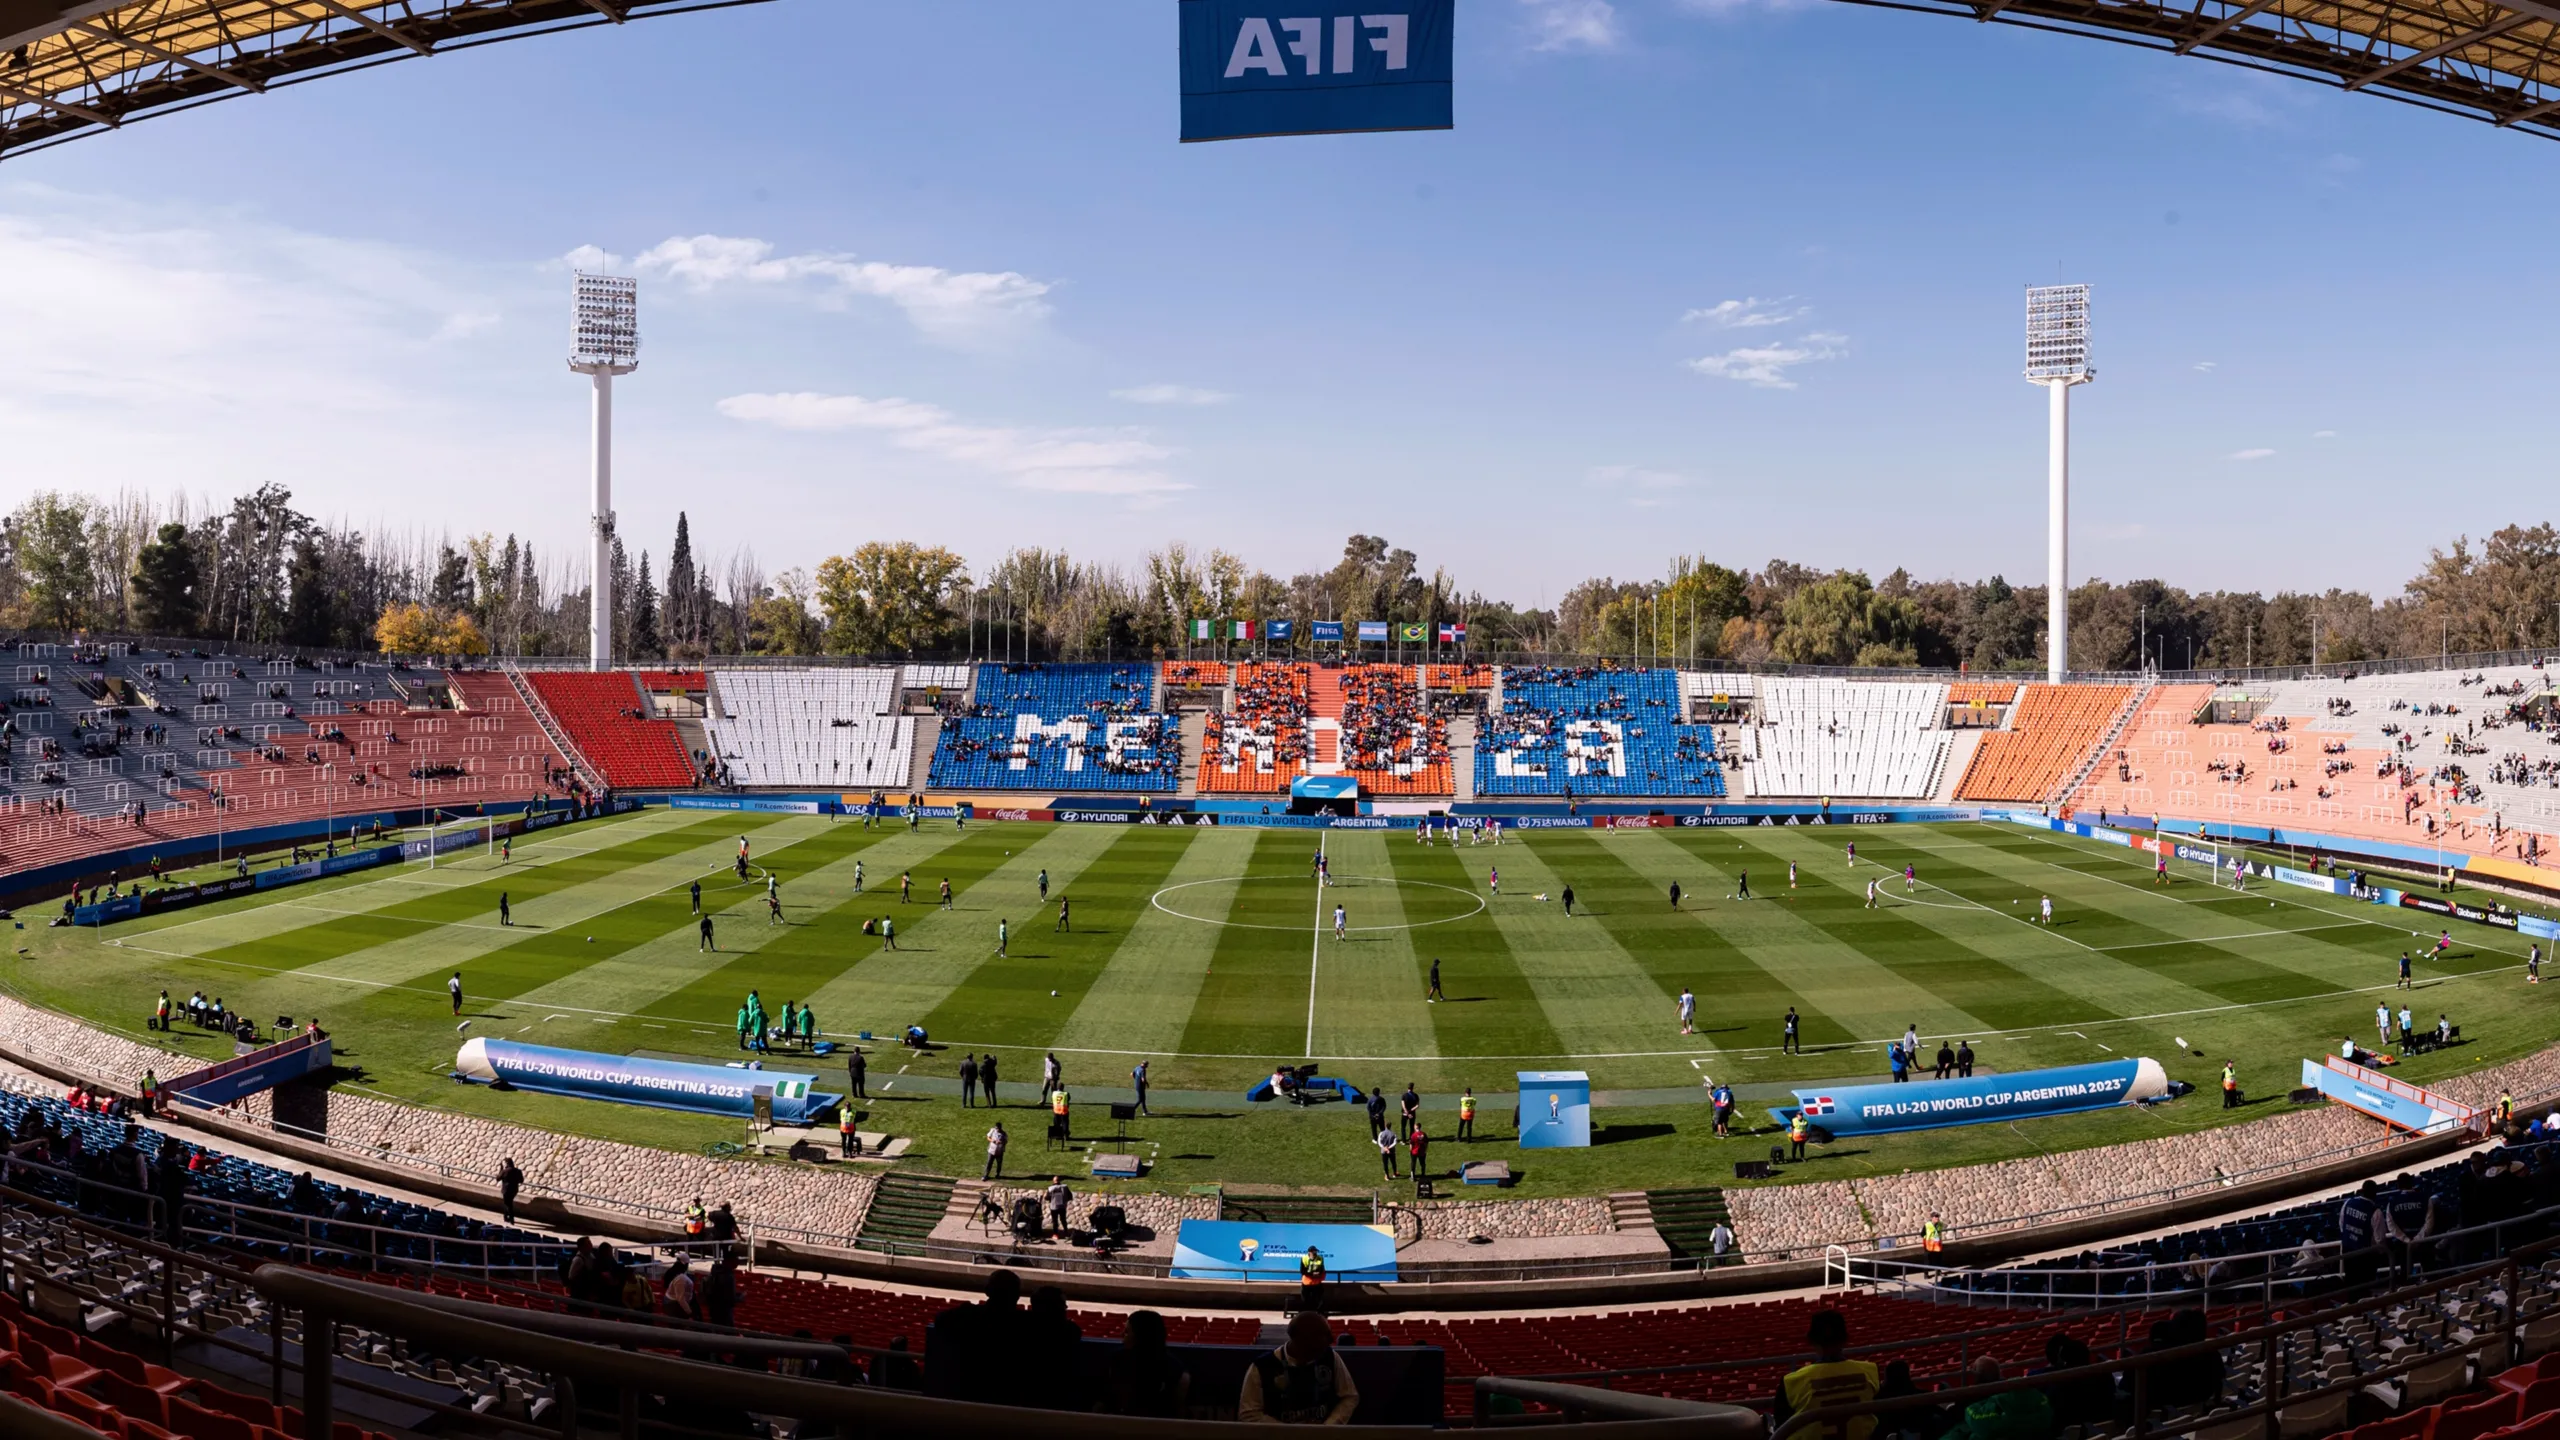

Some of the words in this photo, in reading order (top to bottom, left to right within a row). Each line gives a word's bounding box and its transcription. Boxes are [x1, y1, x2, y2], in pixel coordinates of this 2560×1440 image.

[1315, 627, 1339, 635] FIFA
[754, 803, 808, 811] FIFA.com/tickets
[843, 804, 868, 814] VISA
[995, 808, 1030, 821] Coca-Cola
[1081, 813, 1128, 822] HYUNDAI
[1916, 812, 1970, 821] FIFA.com/tickets
[1224, 815, 1246, 824] FIFA
[1247, 816, 1270, 825] U-20
[1271, 816, 1311, 826] WORLD
[1333, 818, 1388, 827] ARGENTINA
[1389, 818, 1415, 827] 2023
[1456, 818, 1482, 827] VISA
[1616, 816, 1650, 827] Coca-Cola
[1702, 816, 1748, 825] HYUNDAI
[2189, 850, 2217, 864] HYUNDA
[2456, 907, 2482, 920] Globant
[2488, 913, 2514, 926] Globant
[496, 1056, 523, 1071] FIFA
[525, 1062, 555, 1076] U-20
[556, 1065, 604, 1082] WORLD
[605, 1072, 633, 1085] CUP
[633, 1075, 707, 1094] ARGENTINA
[1863, 1103, 1895, 1118] FIFA
[1896, 1101, 1929, 1115] U-20
[1930, 1096, 1983, 1112] WORLD
[1985, 1093, 2012, 1106] CUP
[2013, 1084, 2088, 1102] ARGENTINA
